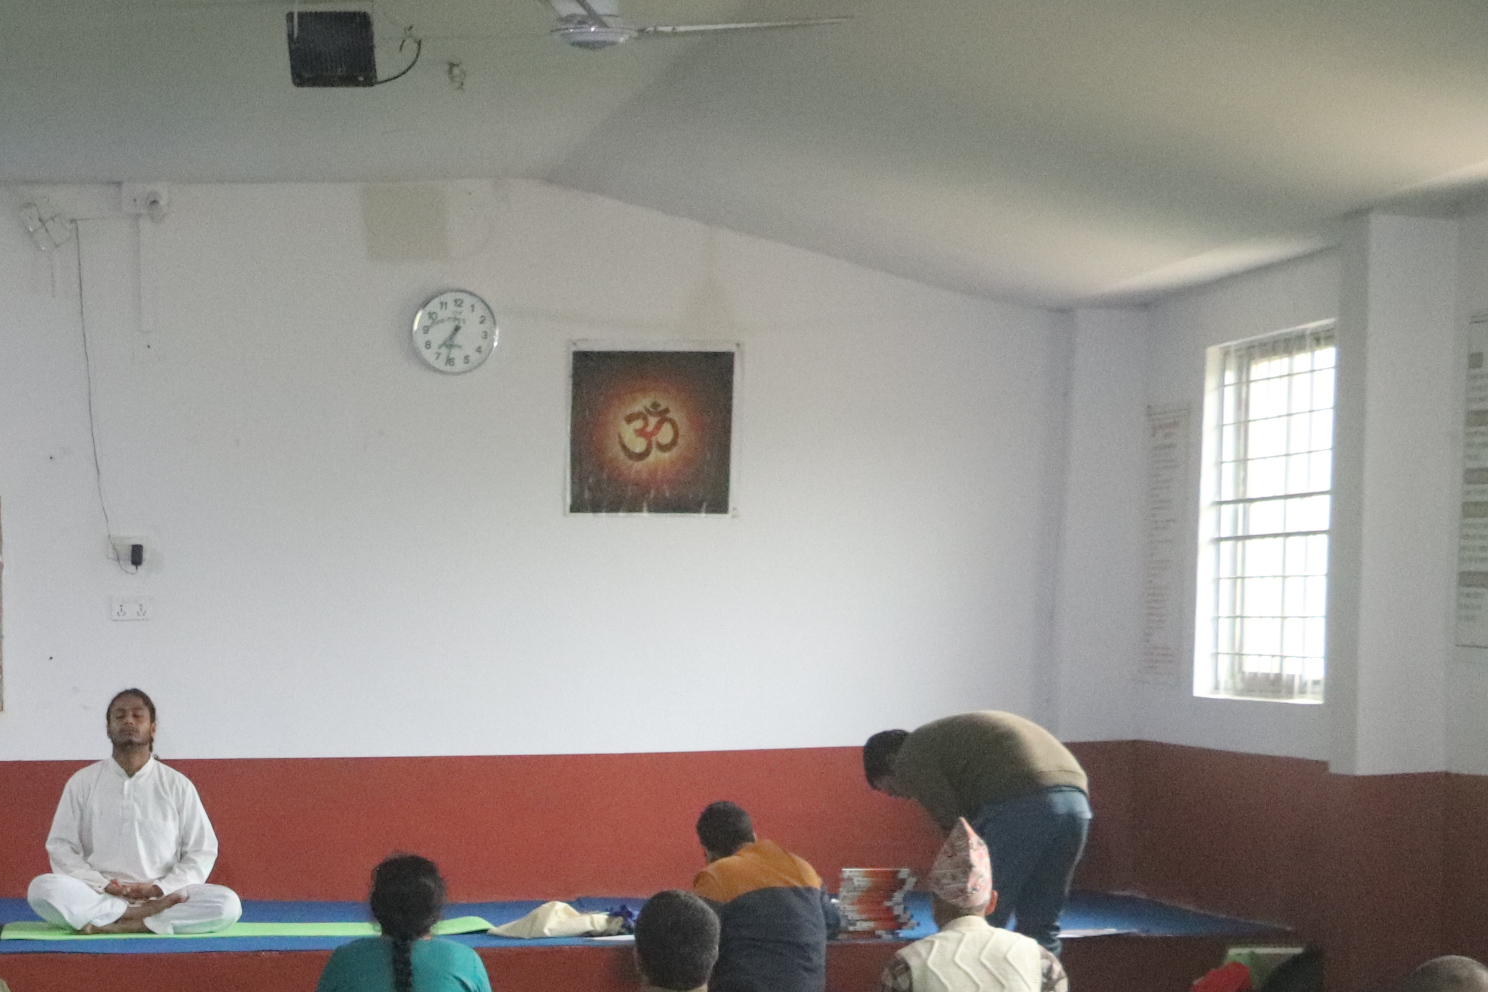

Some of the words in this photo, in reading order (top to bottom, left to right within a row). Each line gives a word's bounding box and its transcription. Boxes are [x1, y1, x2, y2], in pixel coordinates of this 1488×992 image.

[439, 301, 448, 310] 11
[453, 298, 464, 308] 12
[427, 311, 438, 320] 10
[479, 315, 486, 325] 2
[422, 325, 430, 335] 9
[482, 330, 488, 340] 3
[424, 340, 432, 350] 8
[475, 346, 482, 354] 4
[435, 352, 442, 361] 7
[463, 355, 470, 364] 5
